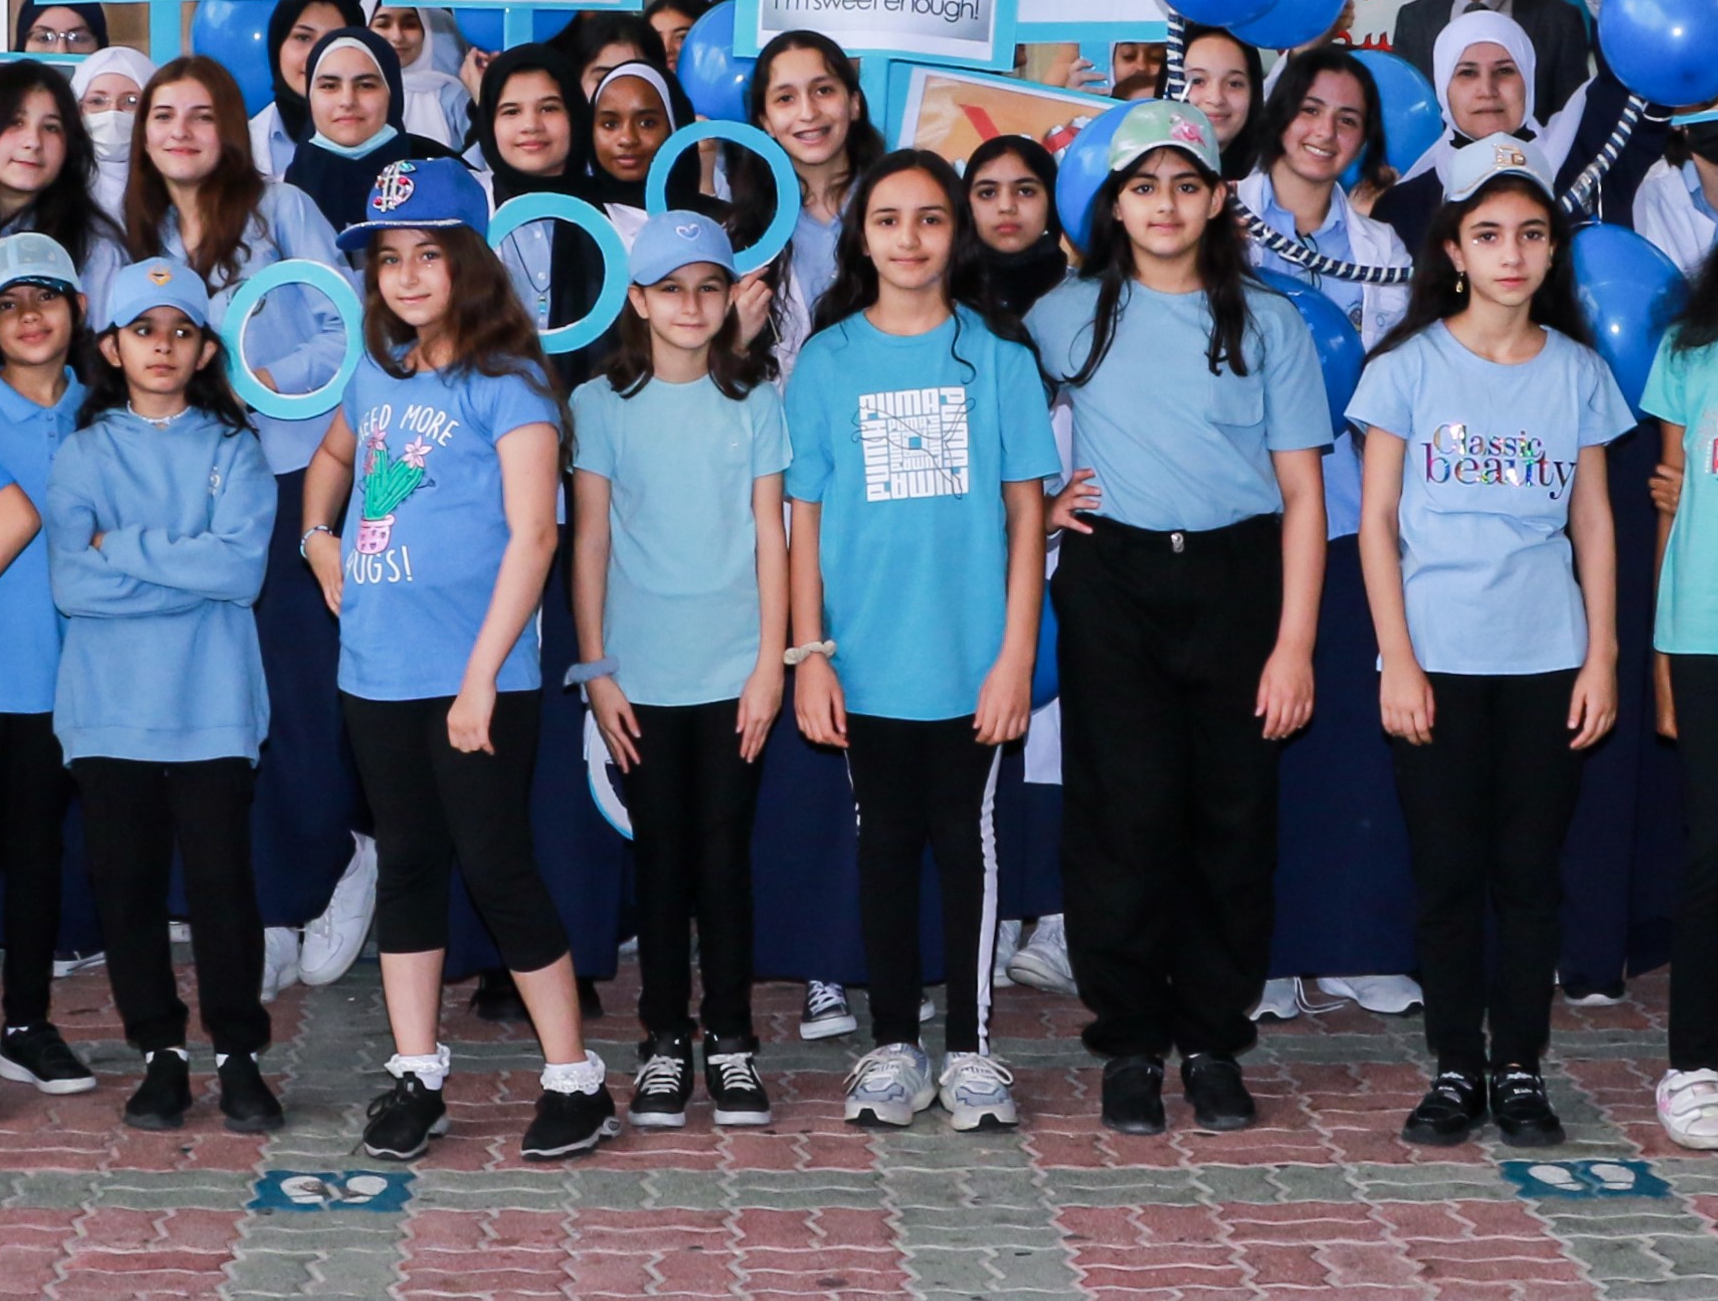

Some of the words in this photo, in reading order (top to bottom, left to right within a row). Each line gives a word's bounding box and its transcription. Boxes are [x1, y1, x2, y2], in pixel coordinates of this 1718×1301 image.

[399, 404, 460, 447] MORE
[1433, 423, 1543, 458] Classic
[1420, 443, 1577, 500] beauty
